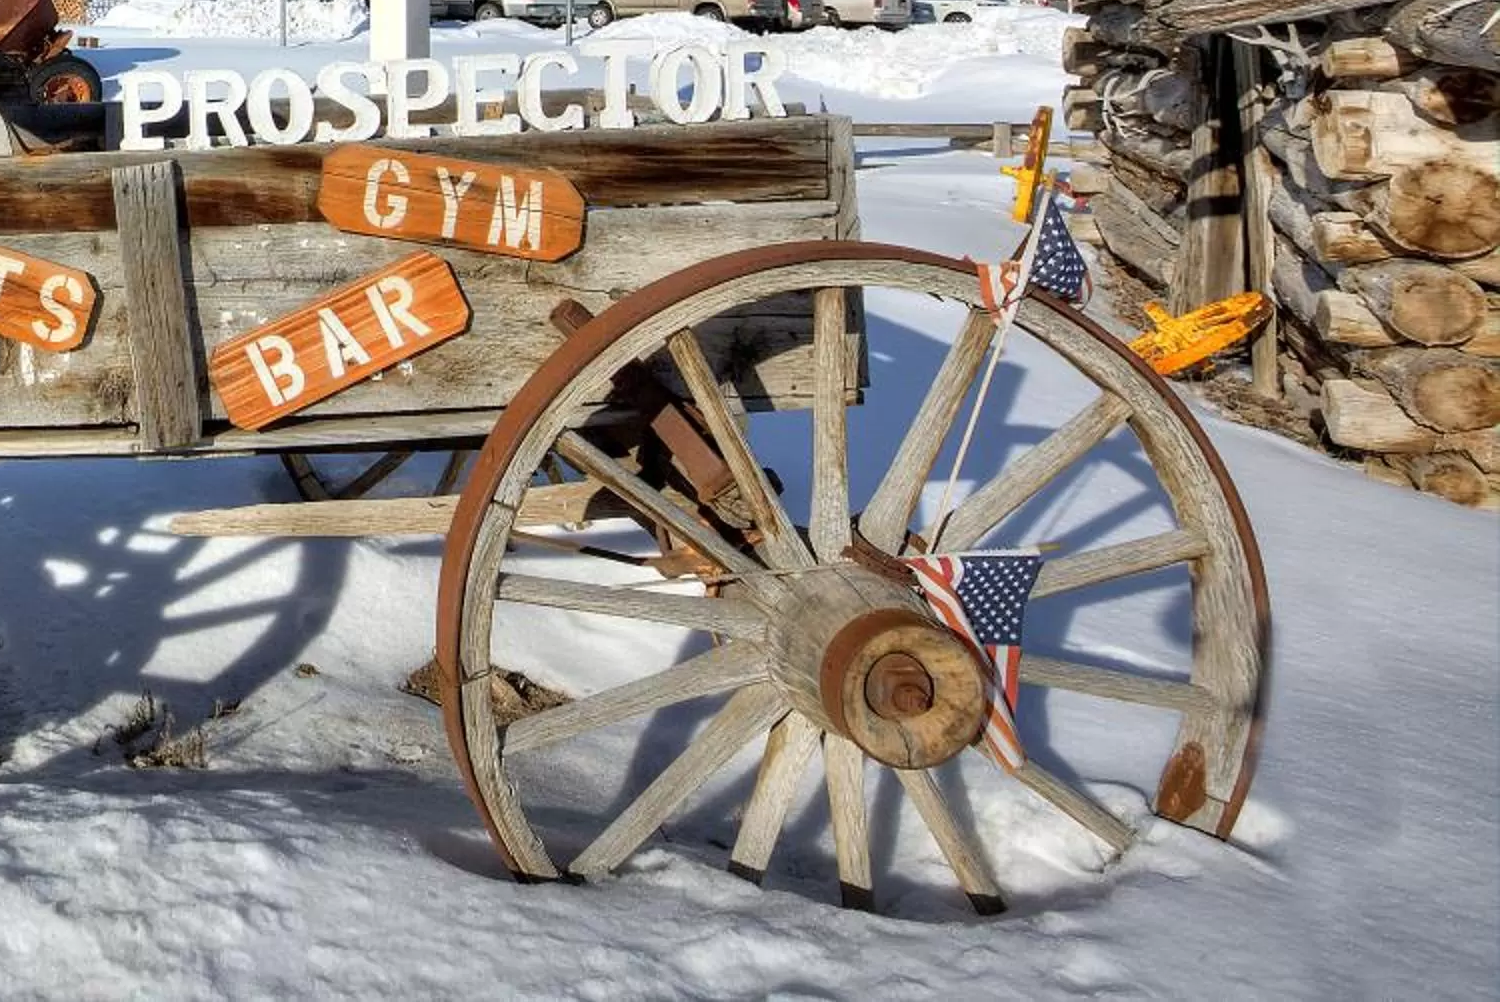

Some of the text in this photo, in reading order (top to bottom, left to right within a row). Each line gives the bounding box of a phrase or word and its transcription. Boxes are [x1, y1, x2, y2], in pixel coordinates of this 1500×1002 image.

[119, 40, 789, 151] PROSPECTOR
[363, 159, 544, 251] GYM
[246, 276, 433, 407] BAR
